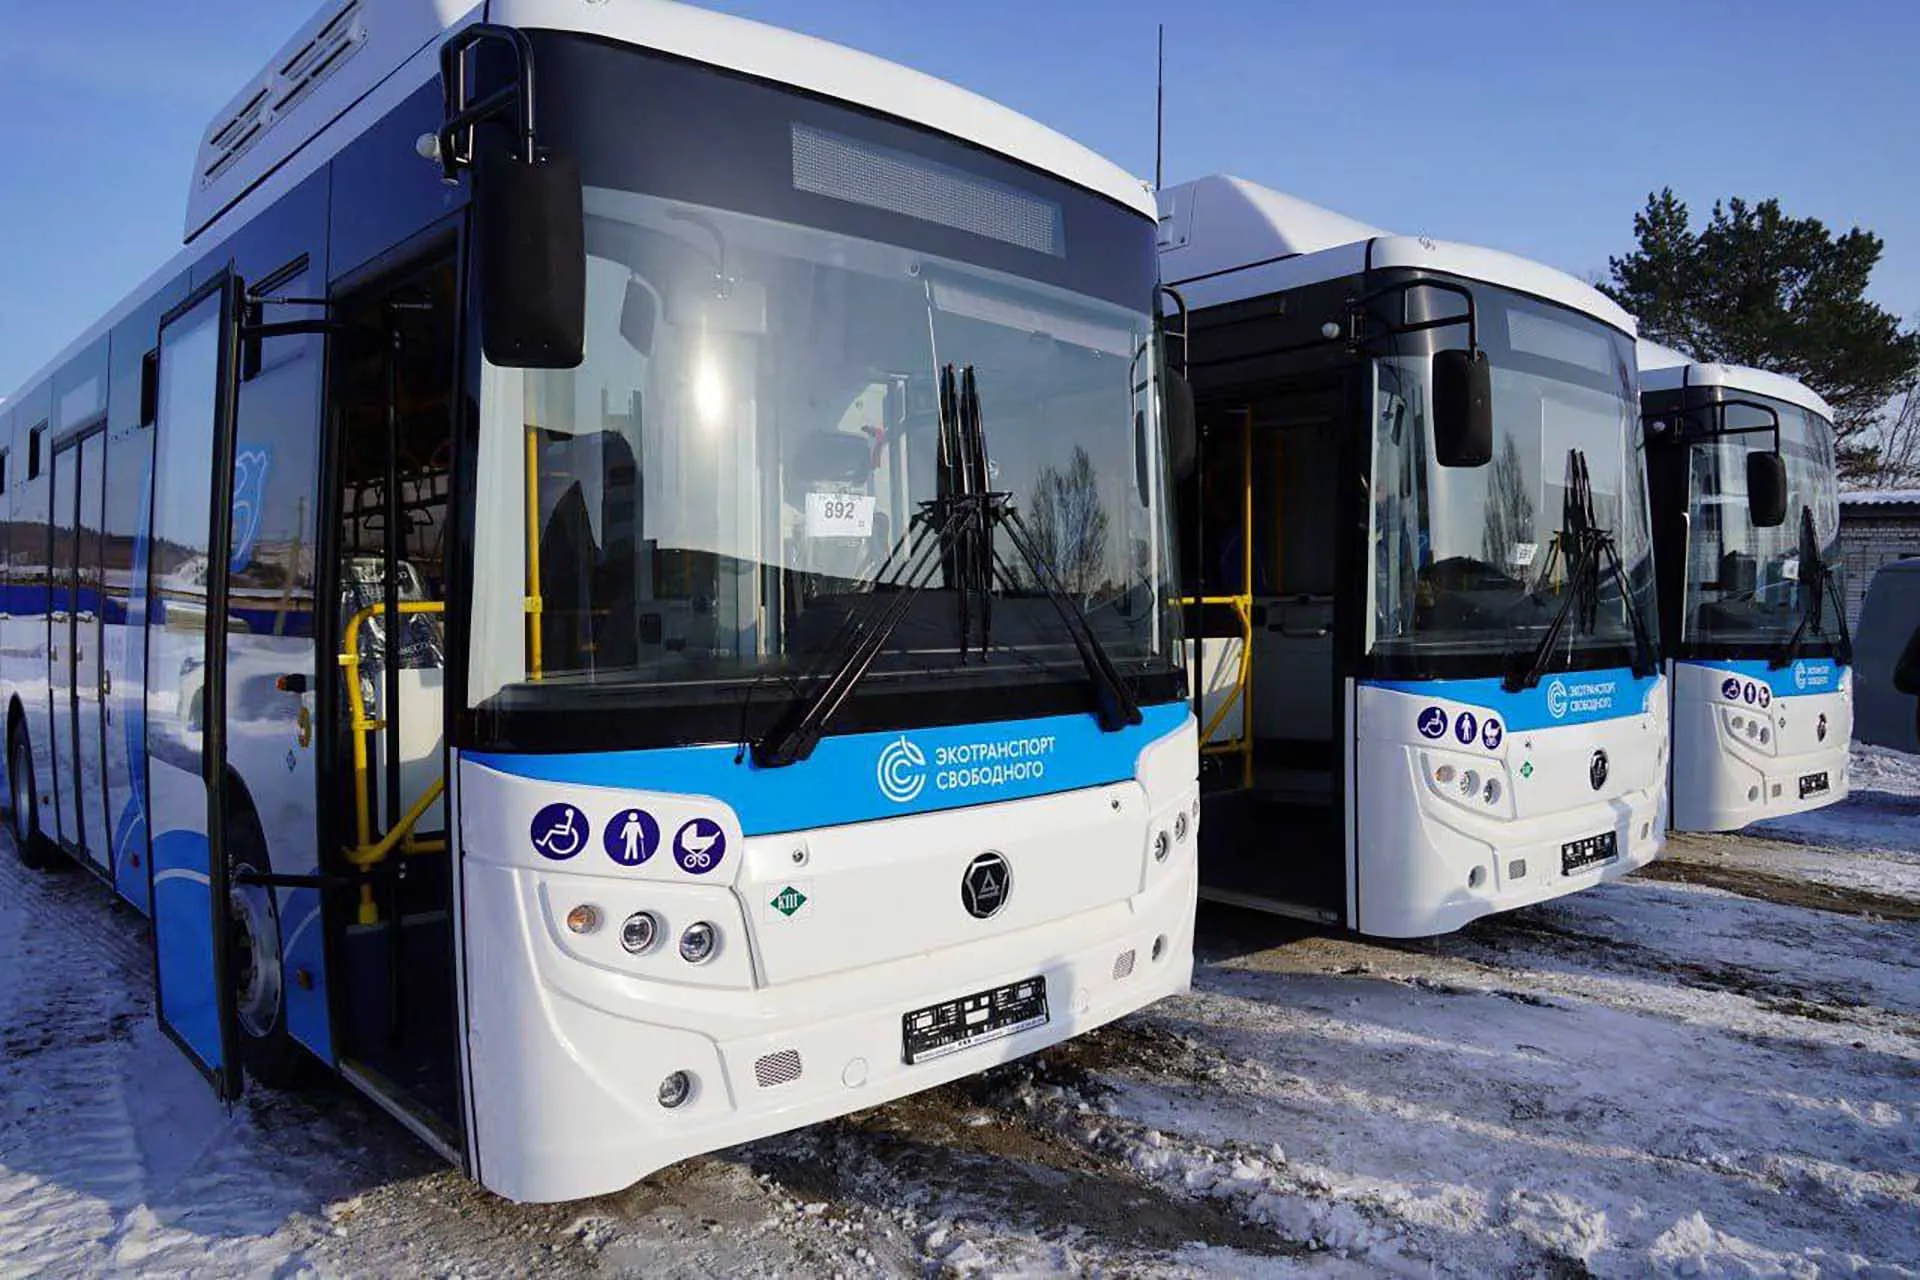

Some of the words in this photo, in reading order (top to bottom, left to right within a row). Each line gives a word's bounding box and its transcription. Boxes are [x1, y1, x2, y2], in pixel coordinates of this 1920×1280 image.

[825, 501, 855, 520] 892
[936, 736, 1056, 766] ЭКОТРАНСПОРТ
[936, 760, 1044, 791] СВОБОДНОГО
